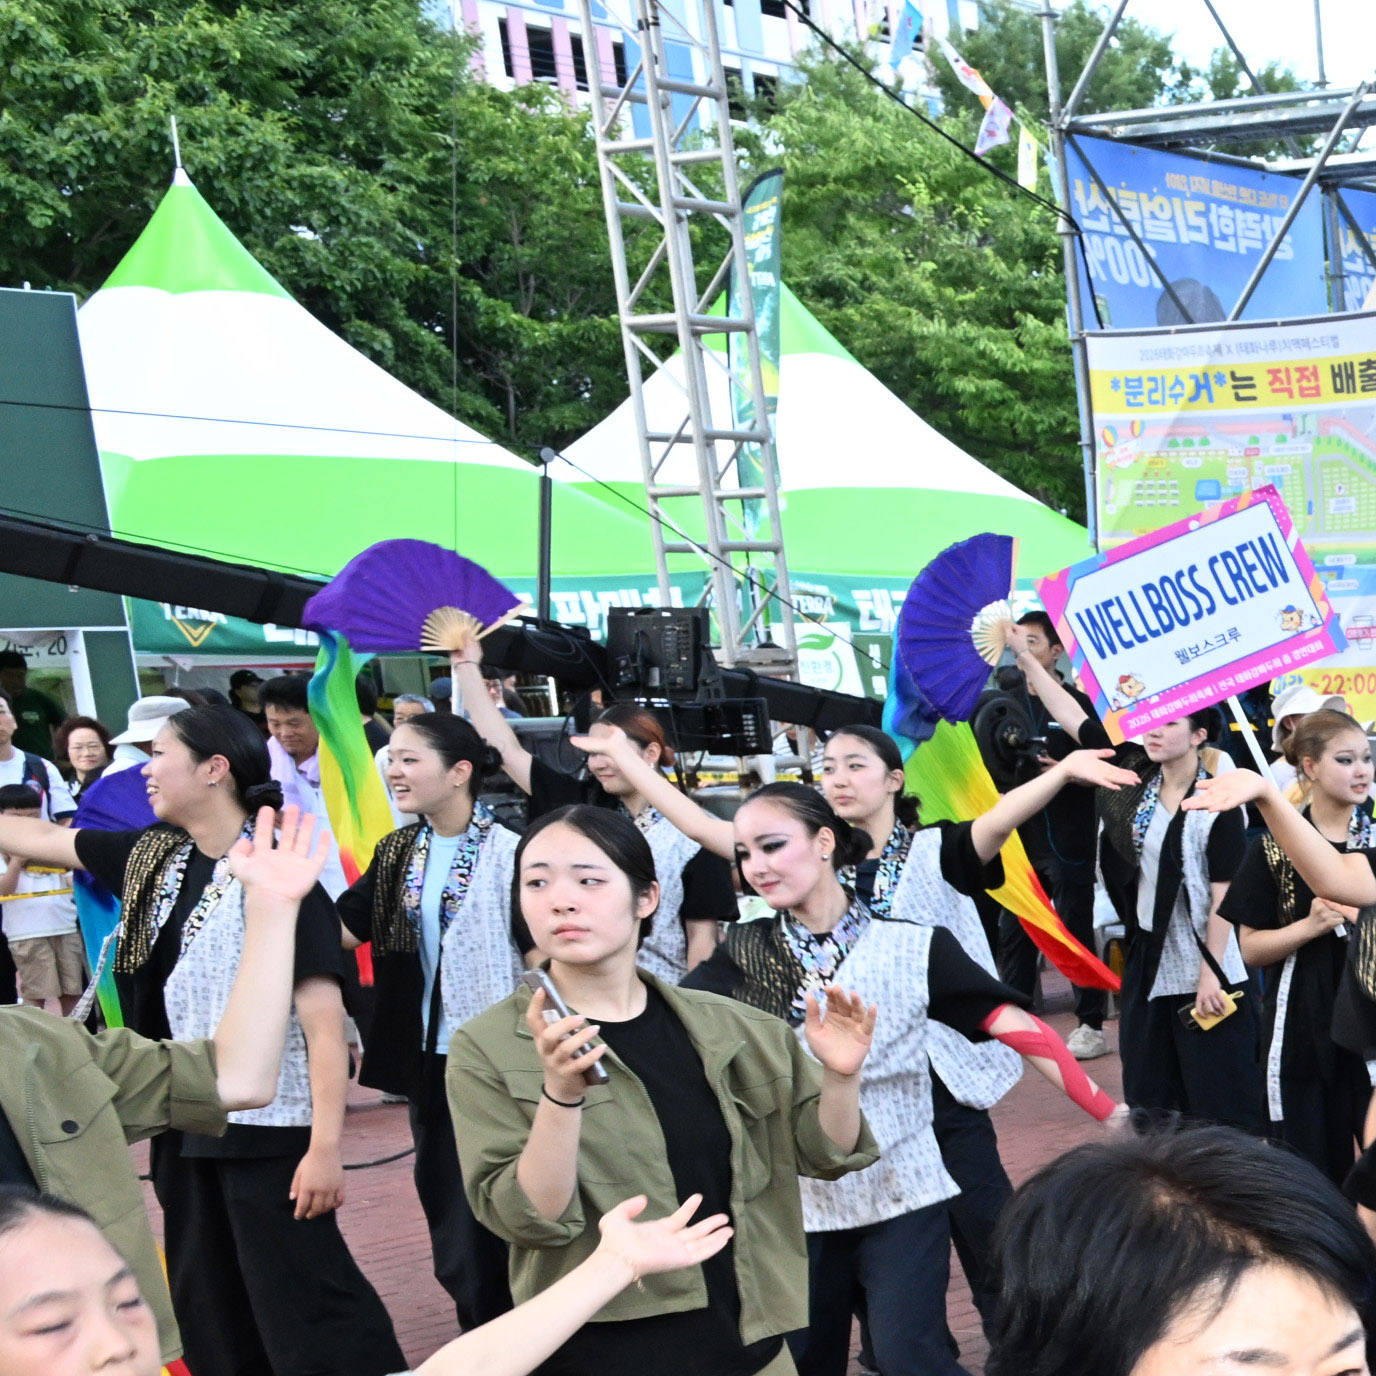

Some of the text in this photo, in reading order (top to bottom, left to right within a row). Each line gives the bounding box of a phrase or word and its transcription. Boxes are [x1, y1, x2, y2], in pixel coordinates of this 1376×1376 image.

[1266, 365, 1322, 399] 직접
[1074, 532, 1290, 661] WELLBOSS CREW
[1175, 627, 1242, 665] 웰보스크루
